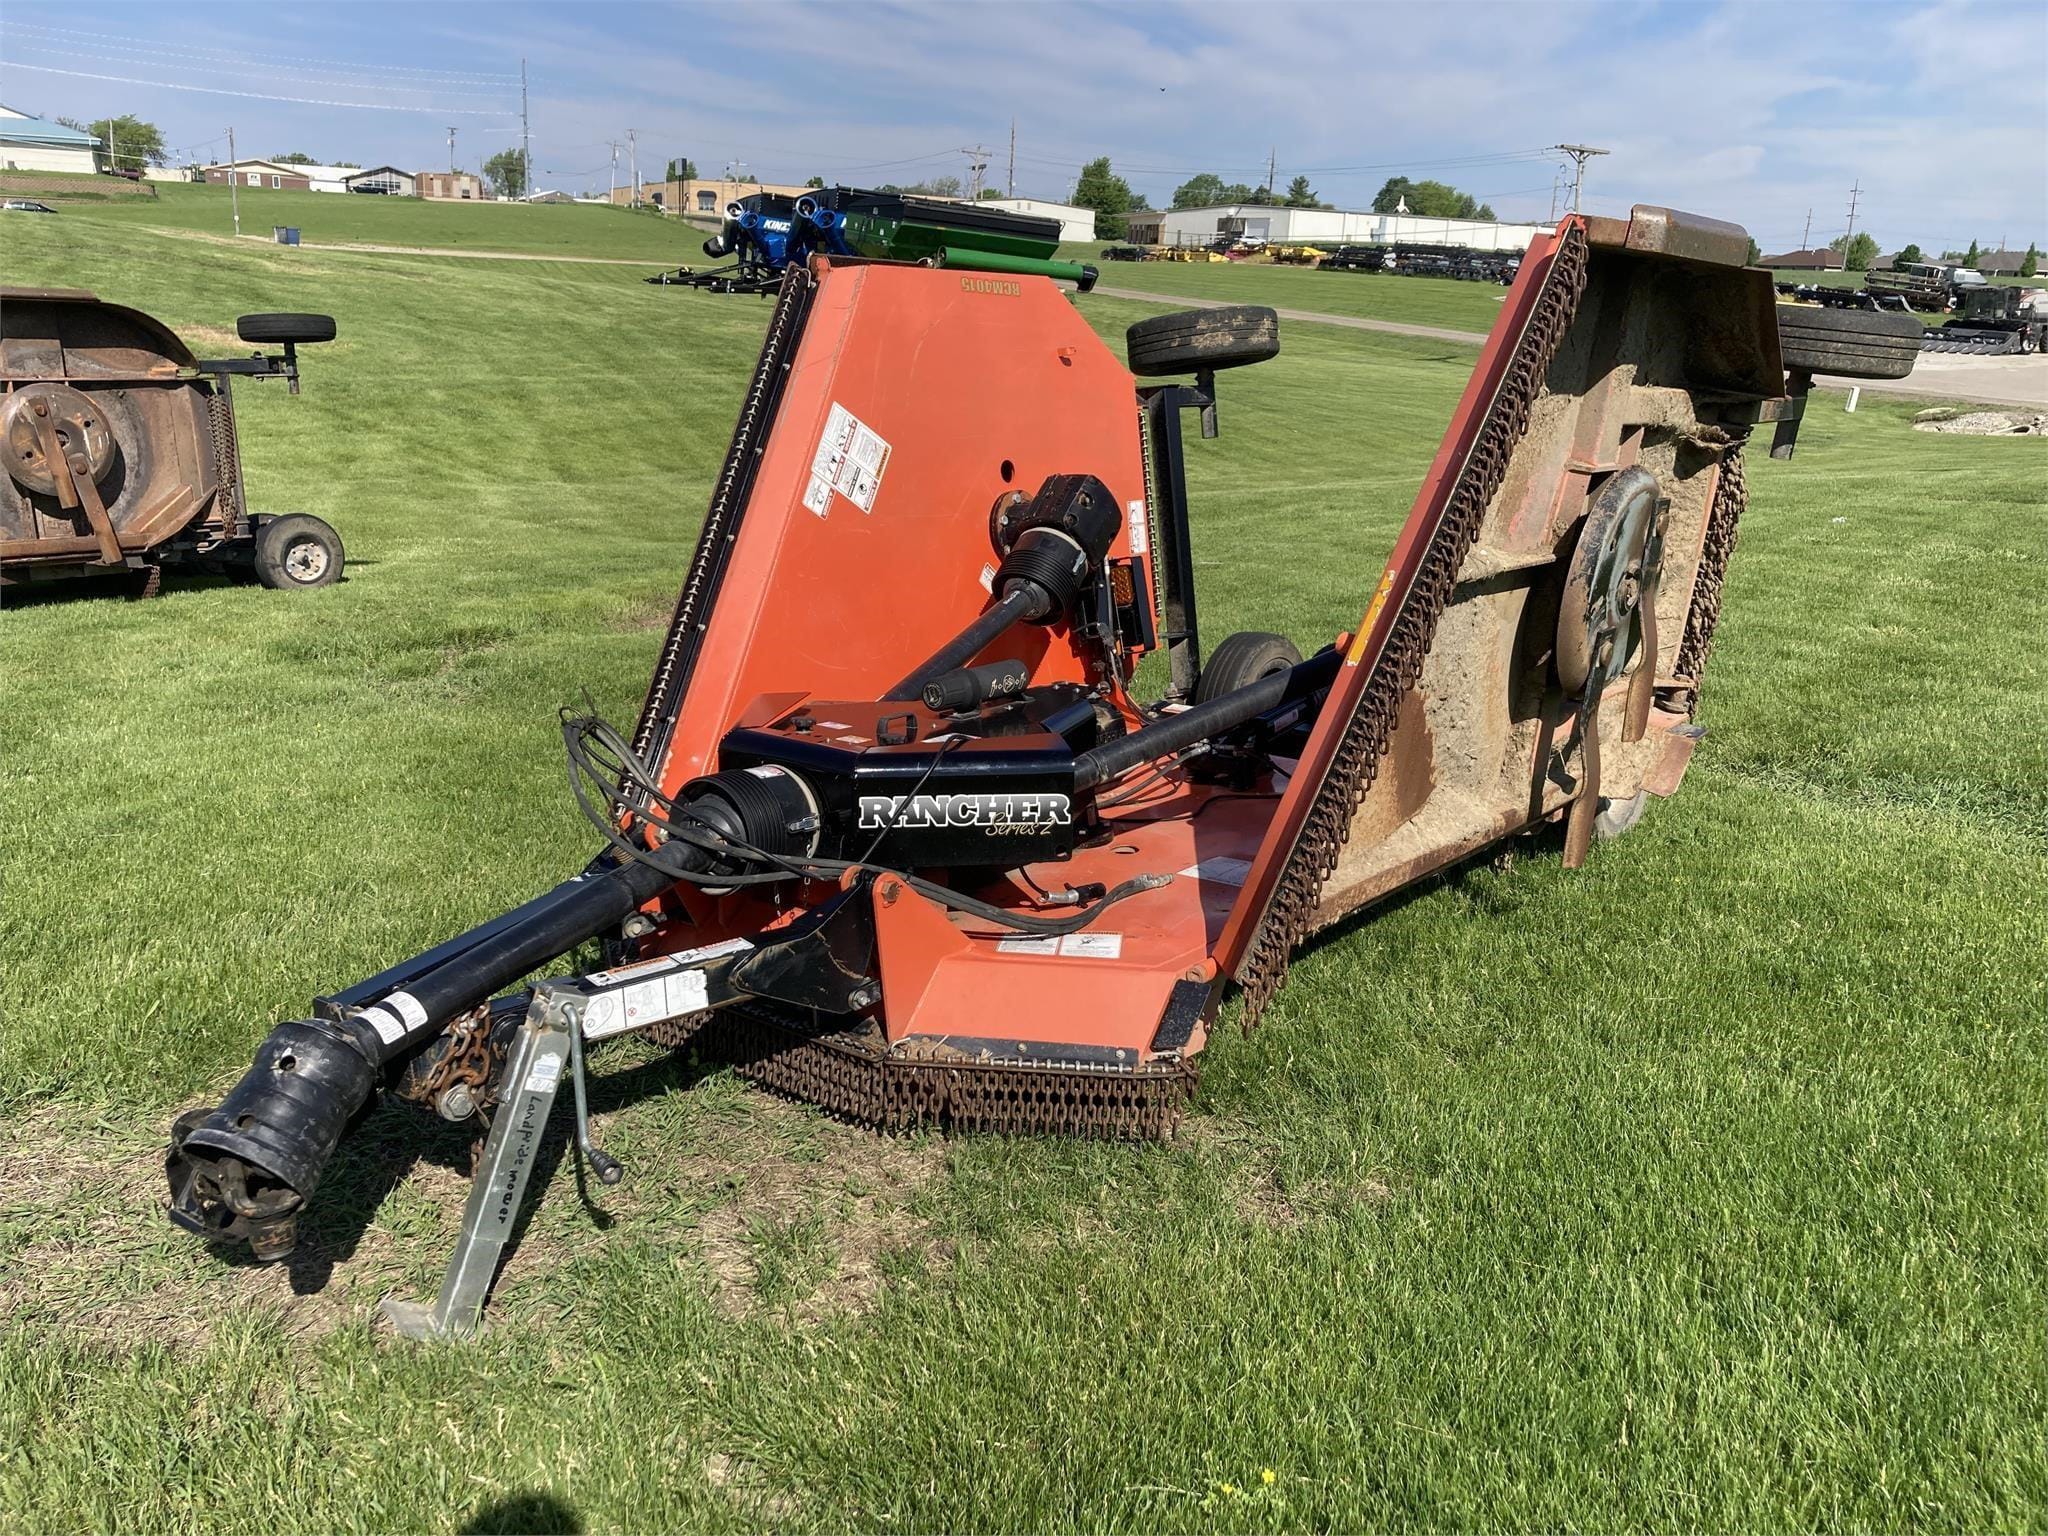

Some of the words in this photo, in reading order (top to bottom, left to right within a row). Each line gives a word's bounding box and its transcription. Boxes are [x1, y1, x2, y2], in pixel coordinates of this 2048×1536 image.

[960, 277, 1021, 297] RCM4015
[858, 794, 1071, 829] RANCHER
[985, 811, 1040, 836] Series
[1040, 816, 1056, 835] 2
[498, 1169, 518, 1226] mower
